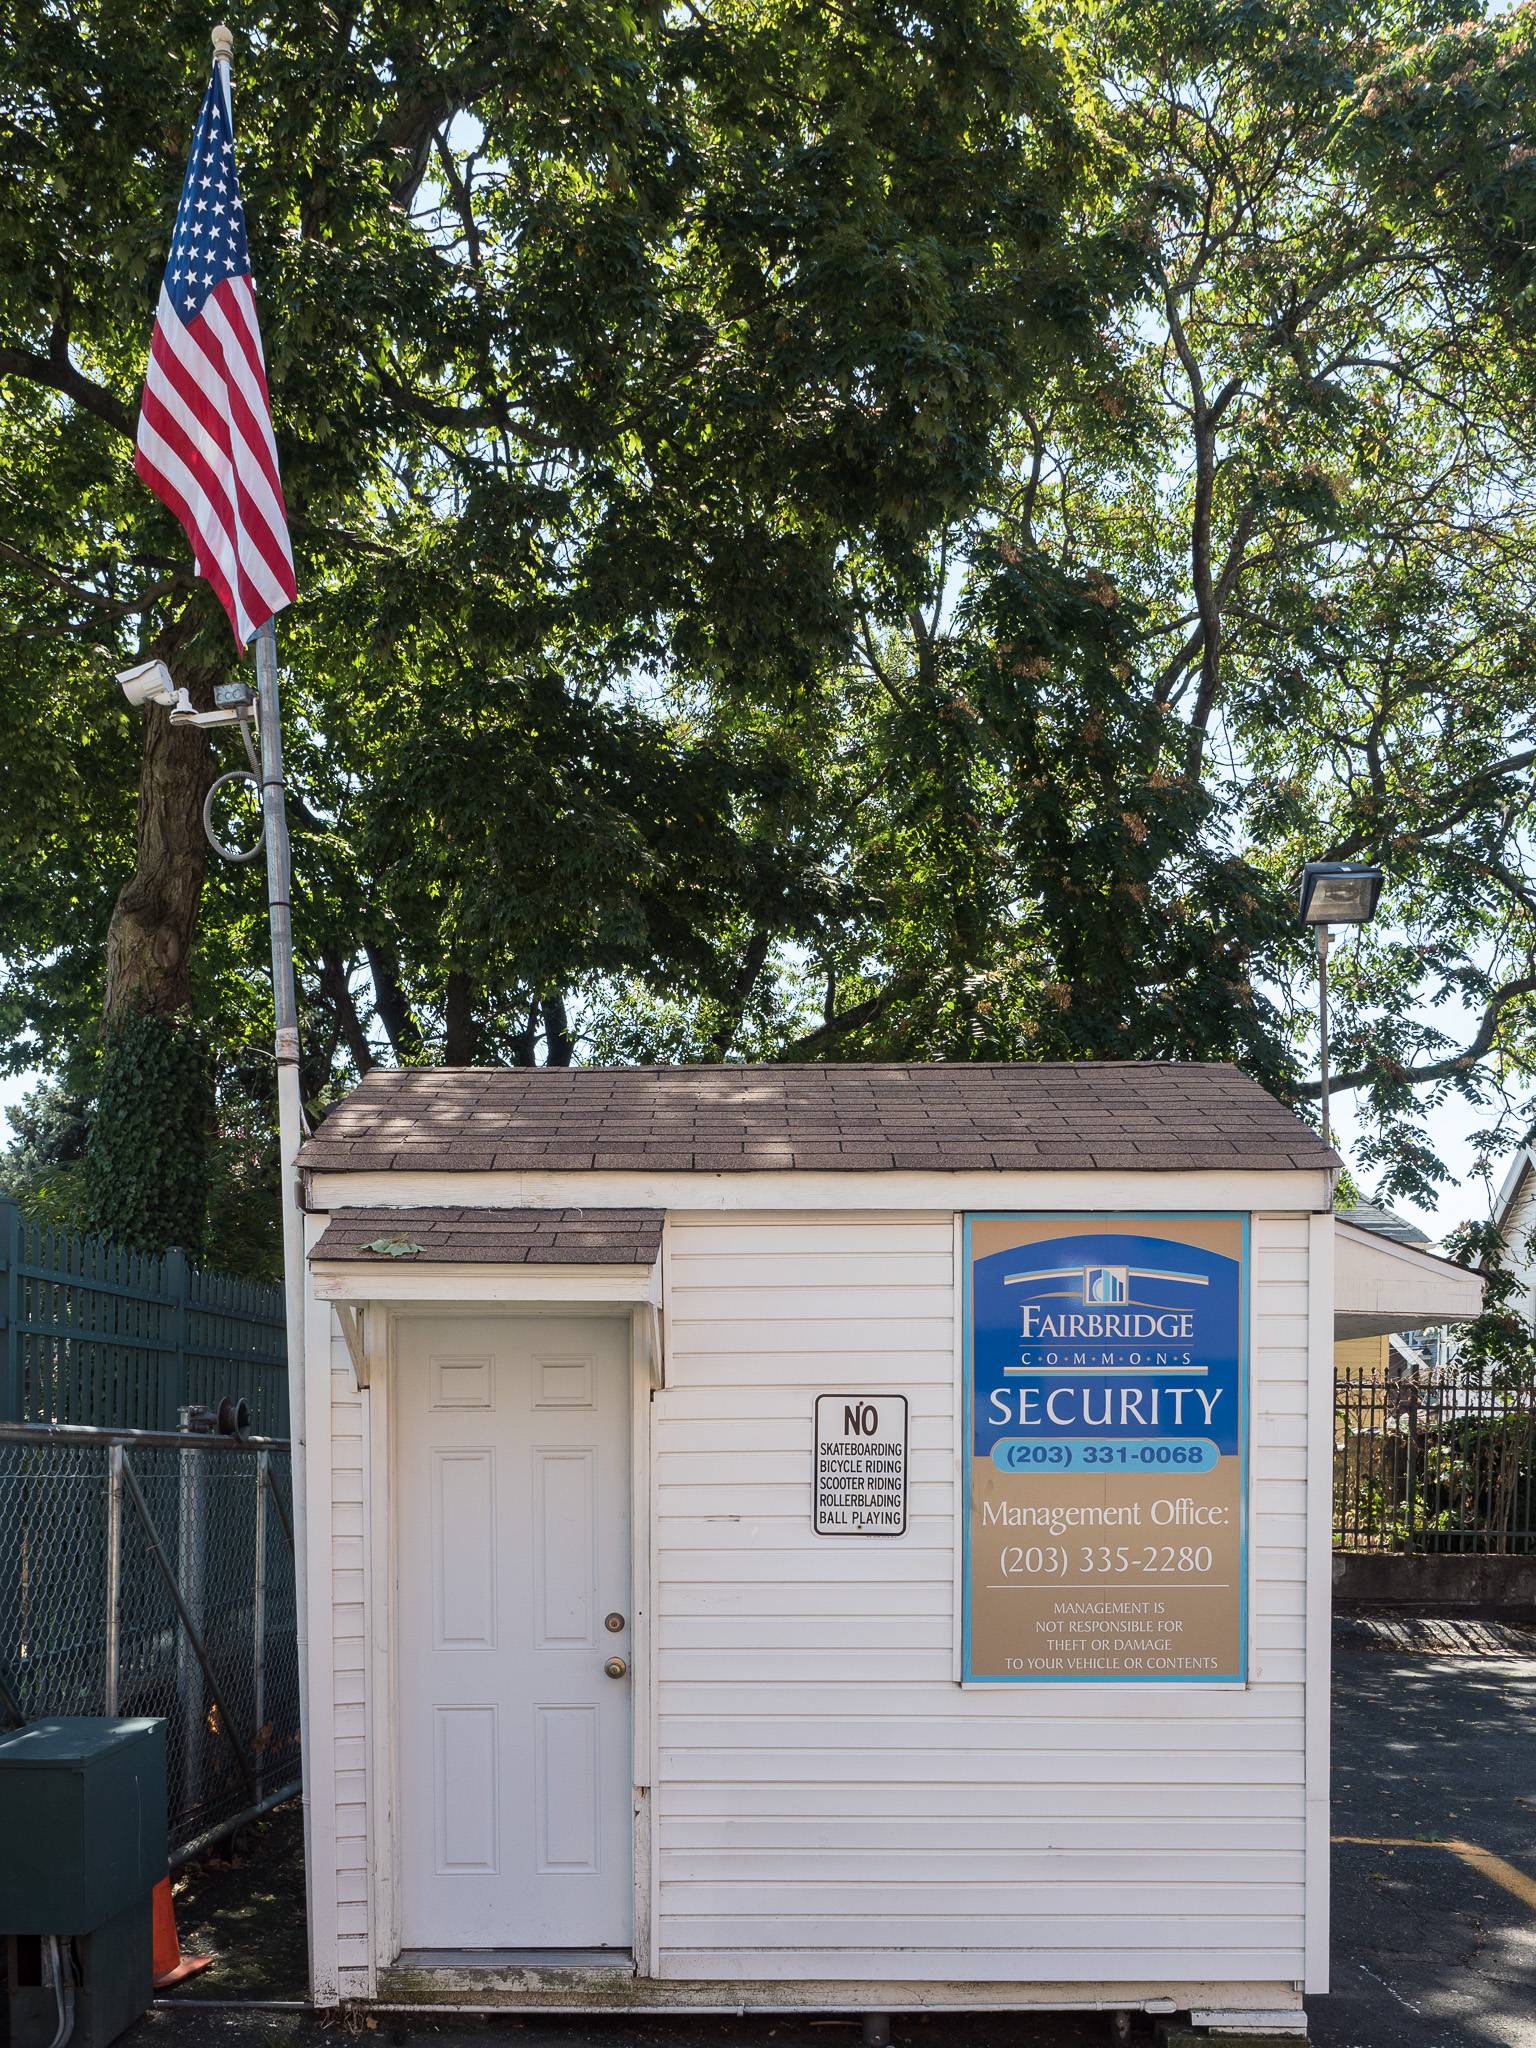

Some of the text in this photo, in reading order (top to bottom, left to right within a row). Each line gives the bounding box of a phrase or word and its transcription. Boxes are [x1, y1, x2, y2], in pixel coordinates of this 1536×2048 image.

[1019, 1305, 1194, 1338] FAIRBRIDGE
[988, 1388, 1223, 1426] SECURITY
[844, 1405, 878, 1436] NO
[820, 1443, 902, 1456] SKATEBOARDING
[1006, 1446, 1203, 1467] (203) 331-0068
[820, 1460, 902, 1473] BICYCLE RIDING
[820, 1477, 902, 1490] SCOOTER RIDING
[820, 1494, 901, 1507] ROLLERBLADING
[819, 1512, 900, 1524] BALL PLAYING
[982, 1498, 1230, 1536] Management Office:
[1000, 1546, 1212, 1577] (203) 335-2280
[1054, 1603, 1165, 1614] MANAGEMENT IS
[1036, 1621, 1183, 1633] NOT RESPONSIBLE FOR
[1047, 1639, 1172, 1651] THEFT OR DAMAGE
[1005, 1657, 1218, 1670] TO YOUR VEHICLE OR CONTENTS
